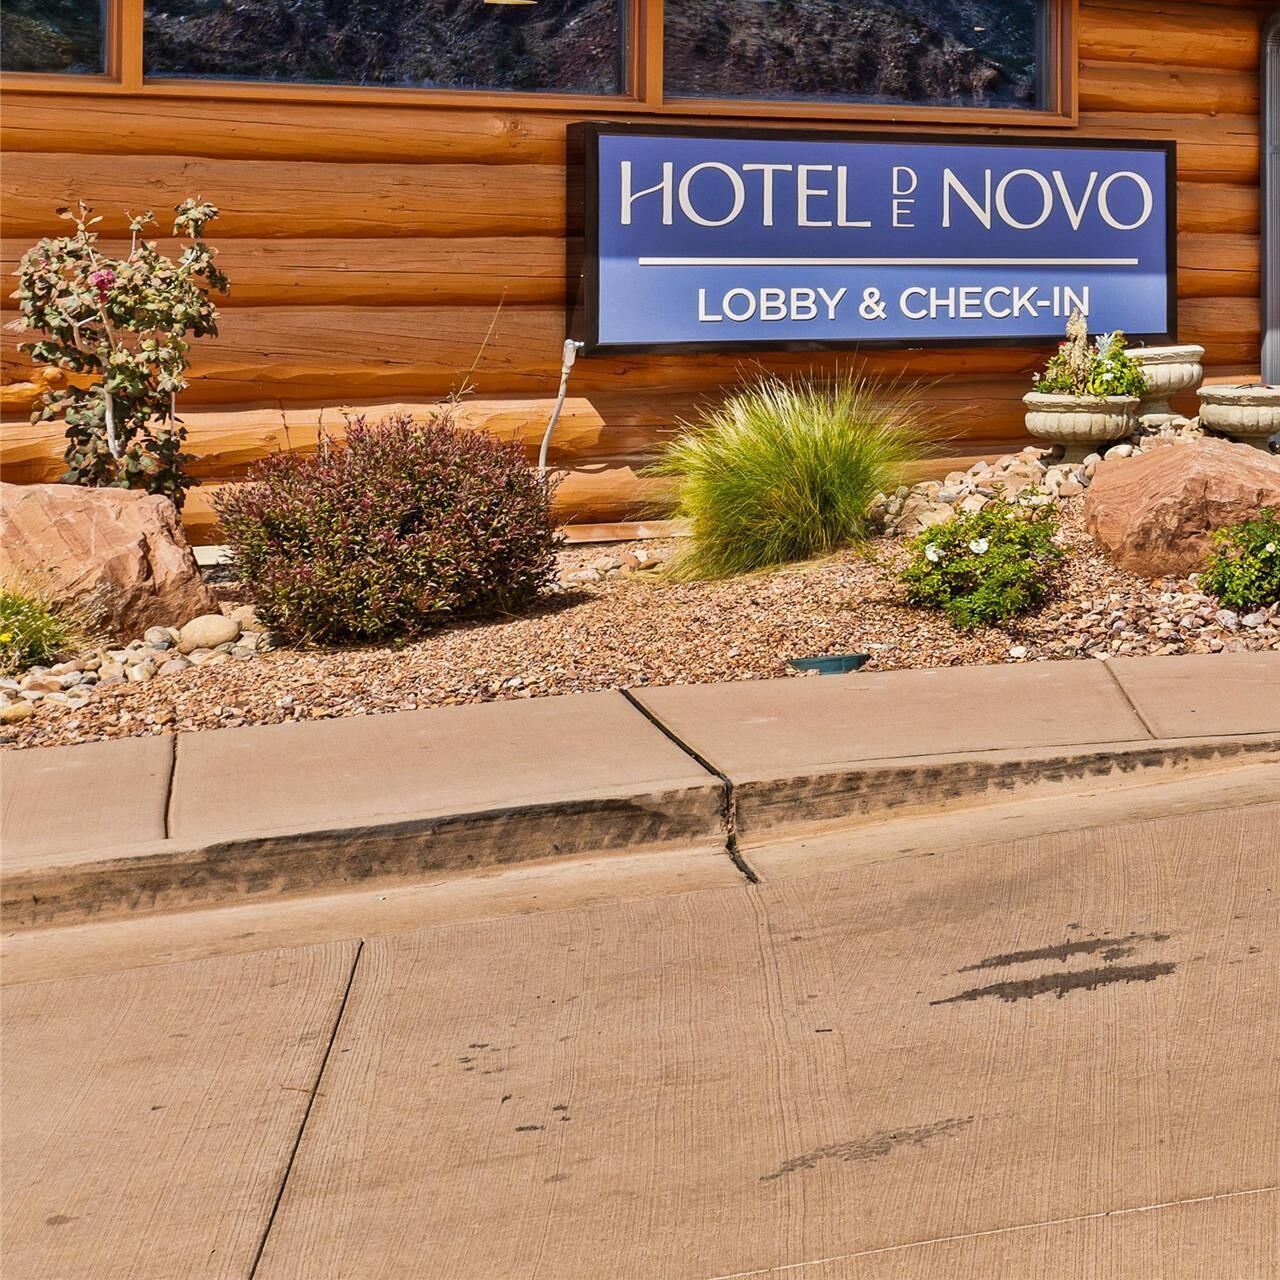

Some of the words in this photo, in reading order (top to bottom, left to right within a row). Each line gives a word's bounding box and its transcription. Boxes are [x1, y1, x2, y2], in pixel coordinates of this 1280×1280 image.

[620, 160, 872, 228] HOTEL
[891, 166, 918, 228] DE
[942, 167, 1153, 231] NOVO
[698, 287, 848, 322] LOBBY
[858, 286, 888, 321] &
[899, 286, 1090, 320] CHECK-IN
